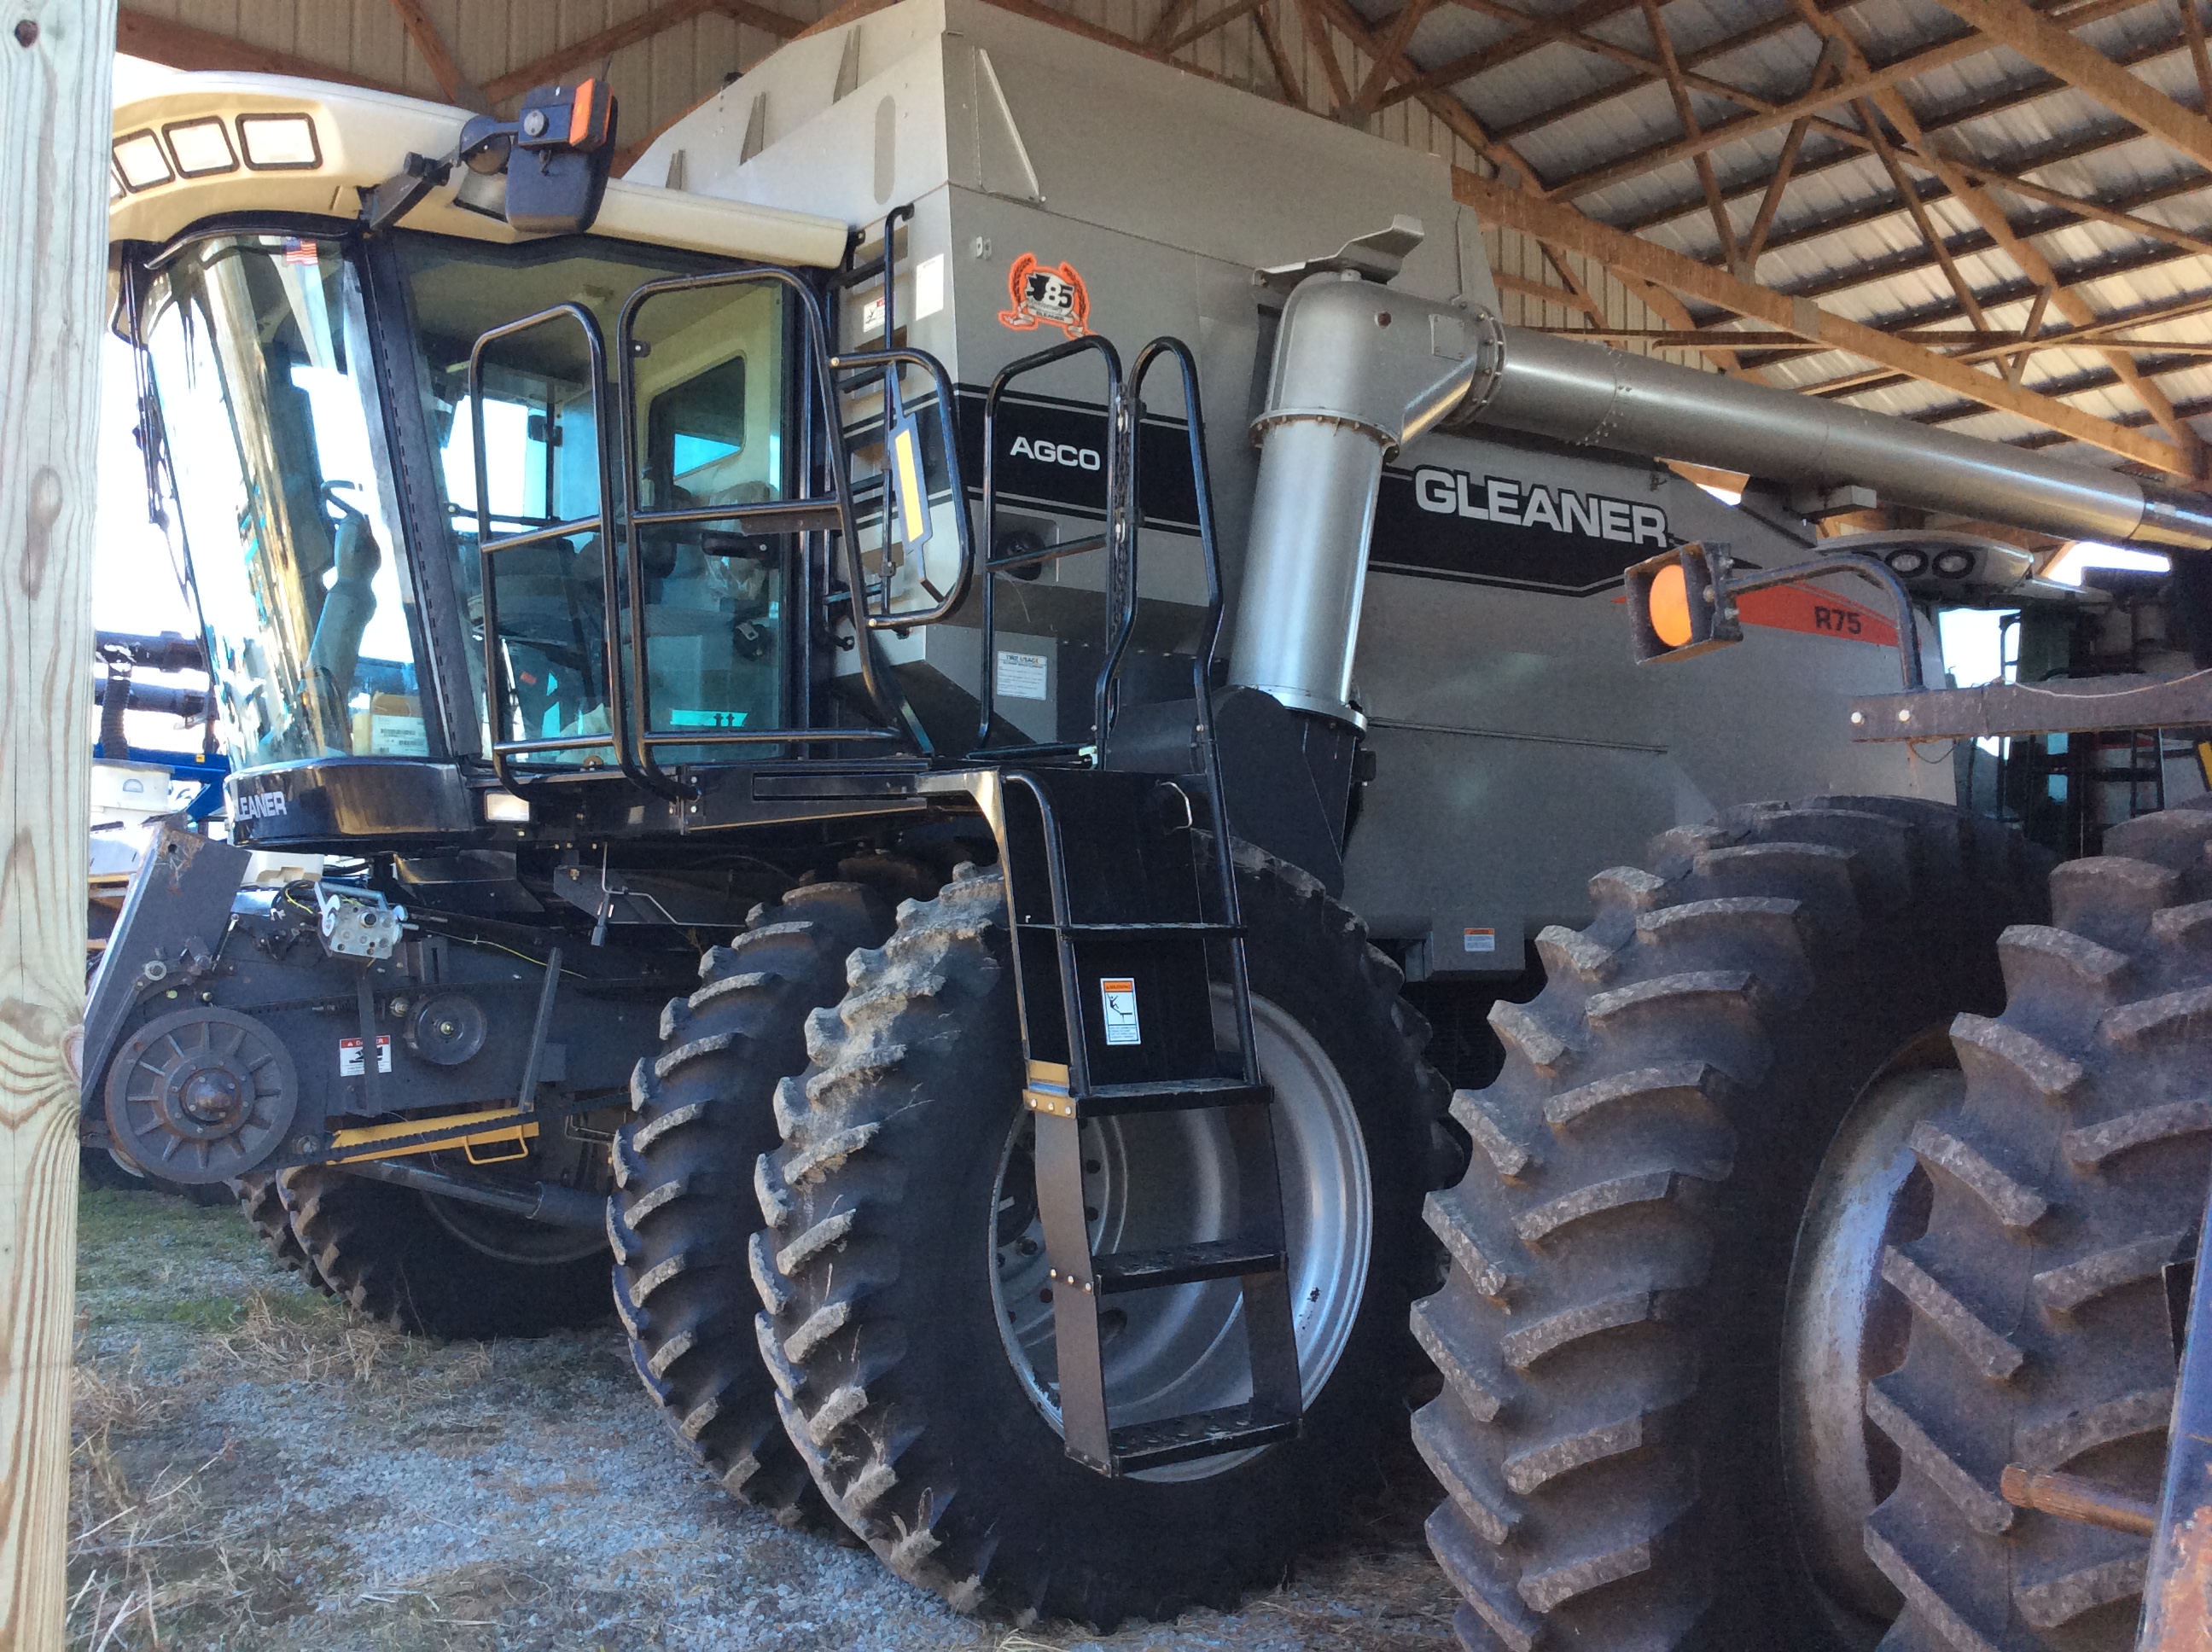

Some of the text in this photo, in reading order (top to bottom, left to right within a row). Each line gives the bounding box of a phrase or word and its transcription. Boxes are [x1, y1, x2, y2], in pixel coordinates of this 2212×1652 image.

[1045, 282, 1074, 308] 85
[1010, 437, 1101, 471] AGCO
[1415, 468, 1668, 548] GLEANER
[1814, 606, 1861, 634] R75
[234, 791, 288, 822] LEANER
